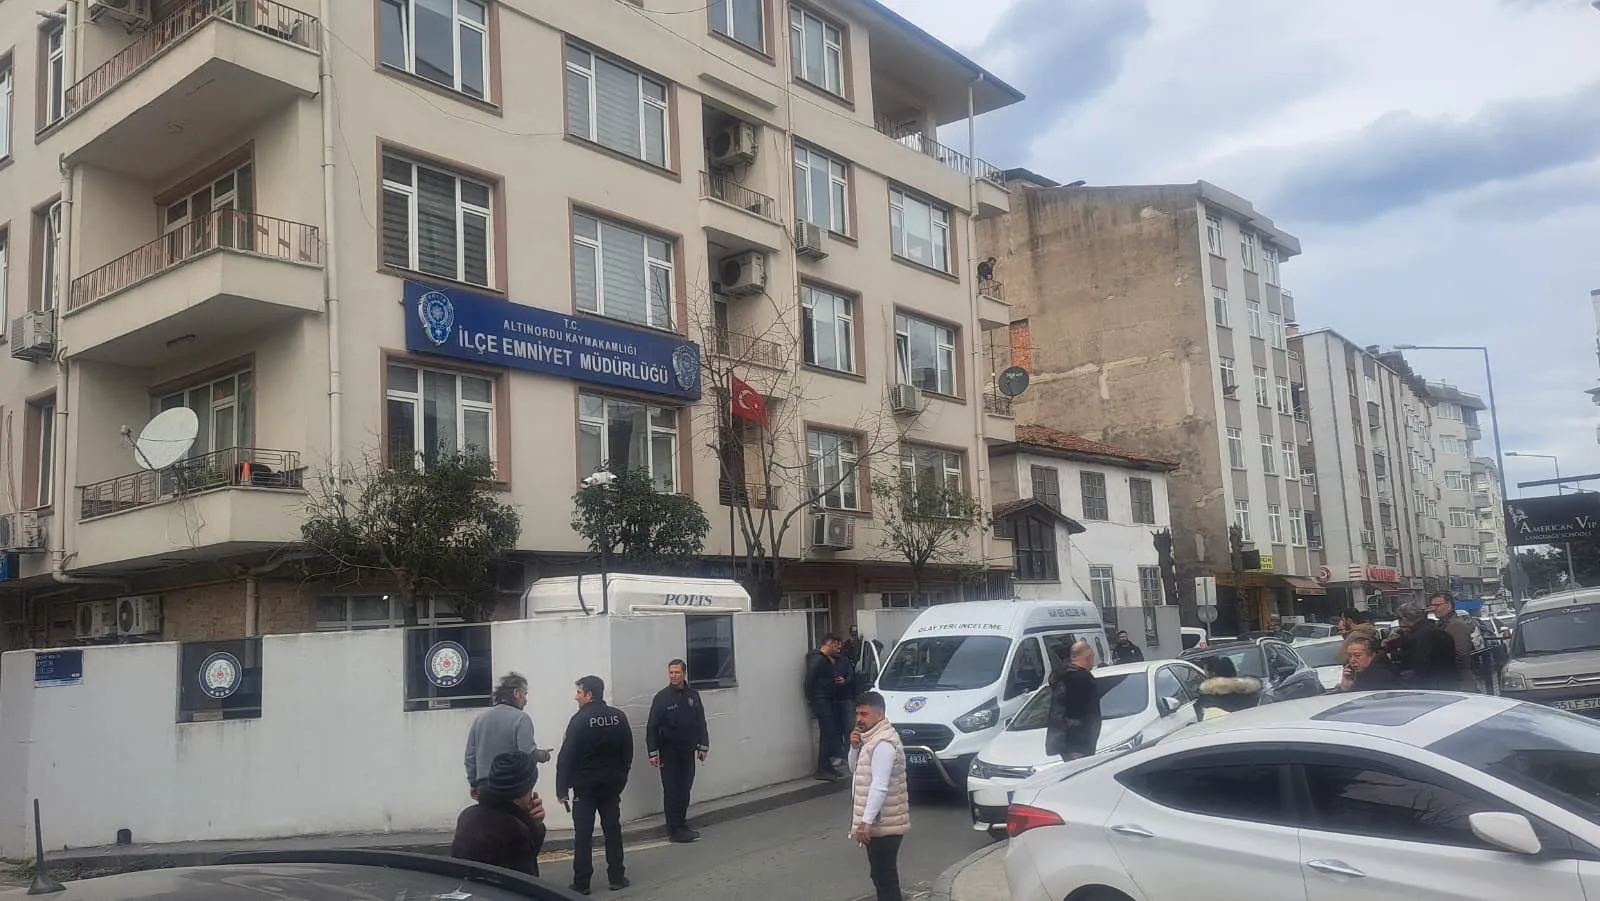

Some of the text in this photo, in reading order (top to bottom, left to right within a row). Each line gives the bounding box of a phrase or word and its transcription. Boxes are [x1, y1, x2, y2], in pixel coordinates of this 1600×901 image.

[503, 320, 637, 356] ALTINORDU KAYMAKAMLIĞI
[563, 319, 580, 331] T.C.
[459, 324, 498, 355] İLÇE
[502, 337, 573, 367] EMNİYET
[580, 351, 669, 385] MÜDÜRLÜĞÜ
